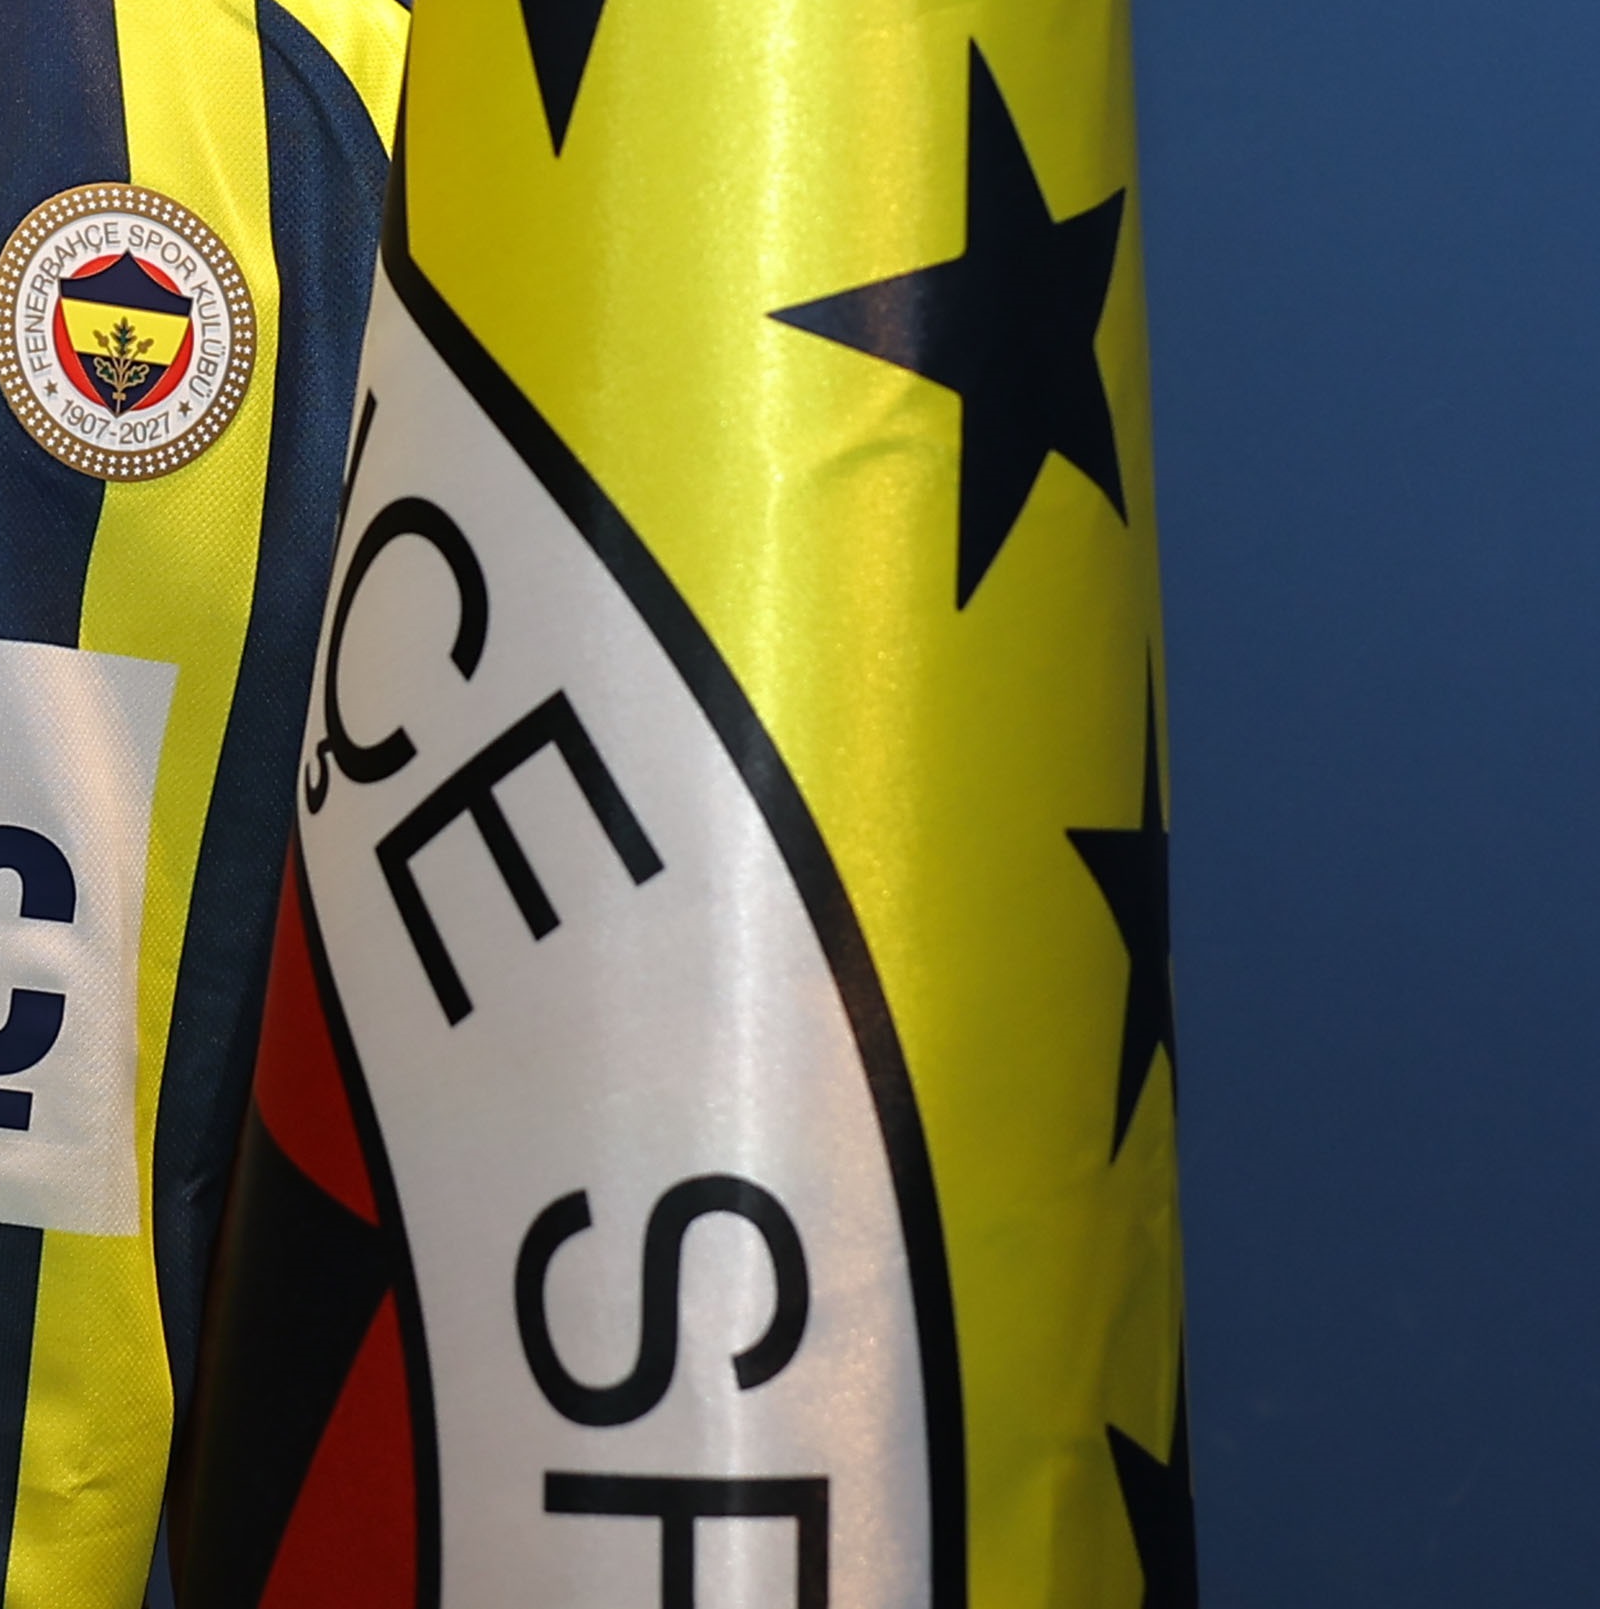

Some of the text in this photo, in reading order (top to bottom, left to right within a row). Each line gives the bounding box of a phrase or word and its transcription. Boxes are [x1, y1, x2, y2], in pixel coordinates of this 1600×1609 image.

[24, 221, 226, 400] FENERBAHÇE SPOR KULÜBÜ
[58, 398, 172, 444] 1907-2027
[304, 386, 665, 1028] ÇE
